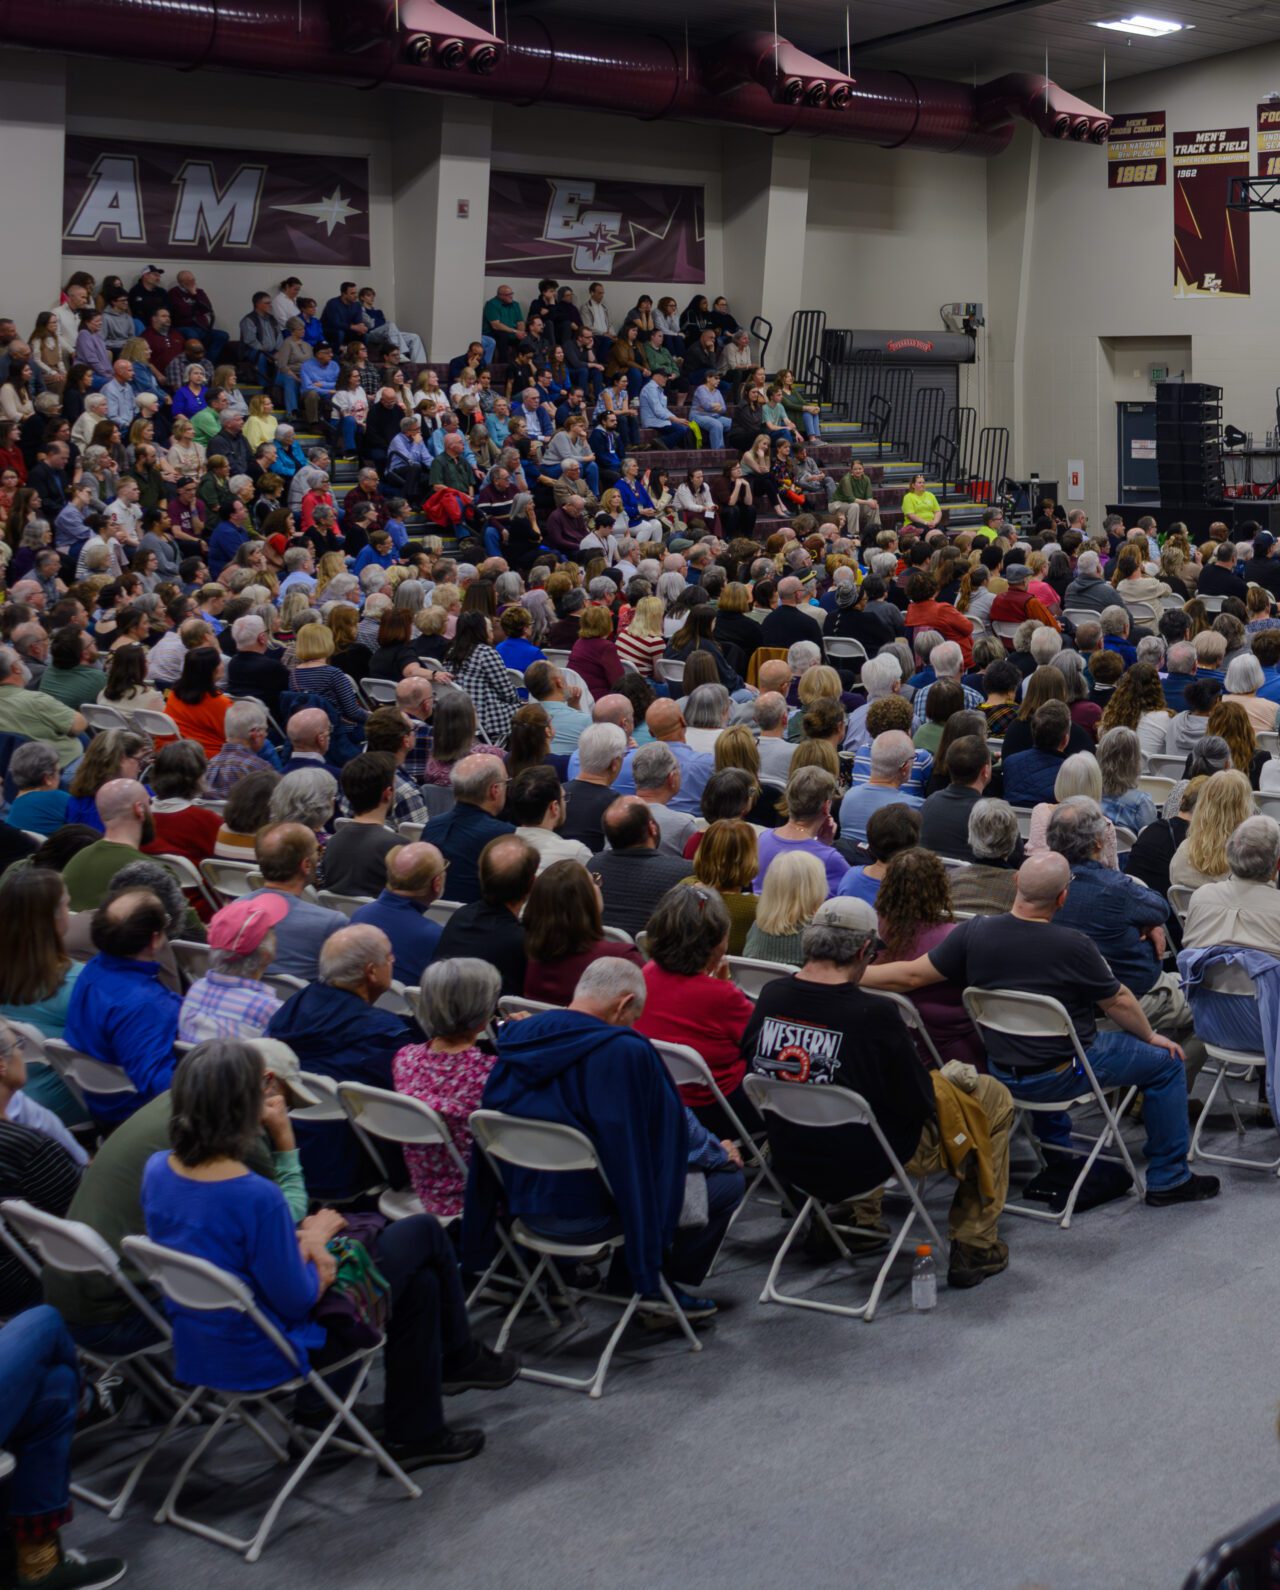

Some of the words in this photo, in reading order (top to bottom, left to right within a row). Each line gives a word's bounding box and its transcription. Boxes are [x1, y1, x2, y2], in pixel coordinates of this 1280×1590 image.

[1196, 132, 1226, 143] MEN'S
[1130, 141, 1163, 150] NATIONAL
[1175, 143, 1205, 154] TRACK
[1209, 144, 1216, 152] &
[1219, 141, 1248, 152] FIELD
[1177, 169, 1198, 178] 1962
[761, 1020, 837, 1058] WESTERN
